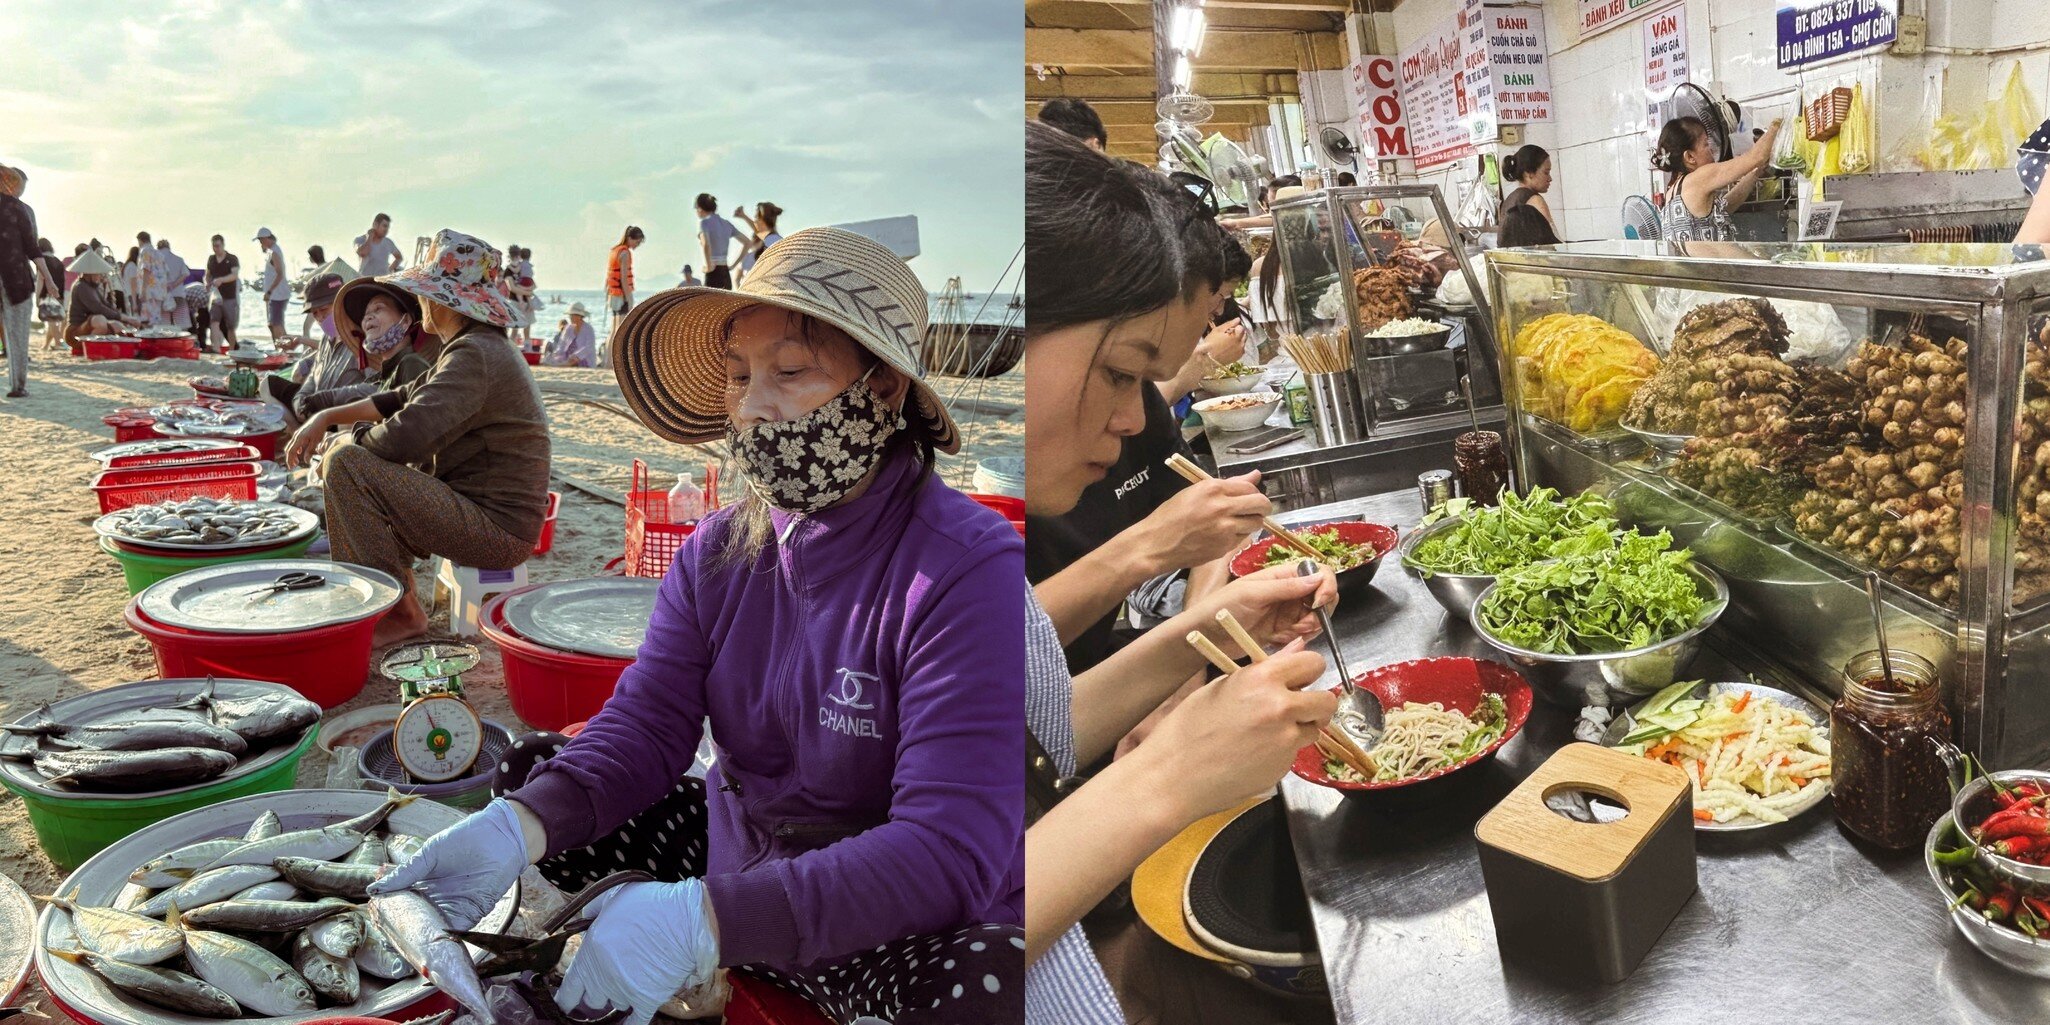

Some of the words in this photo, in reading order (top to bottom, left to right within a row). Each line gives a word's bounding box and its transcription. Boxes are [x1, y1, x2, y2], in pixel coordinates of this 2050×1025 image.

[1496, 15, 1528, 30] BÁNH
[1585, 5, 1608, 28] BÁNH
[1652, 15, 1677, 38] VÂN
[1795, 14, 1809, 35] ĐT:
[1811, 6, 1834, 30] 0824
[1836, 0, 1853, 22] 337
[1792, 42, 1803, 61] 04
[1804, 34, 1825, 58] ĐÌNH
[1827, 29, 1843, 51] 15A
[1493, 51, 1512, 65] CUỐN
[1512, 53, 1526, 64] HEO
[1527, 53, 1543, 65] QUAY
[1503, 71, 1535, 86] BÁNH
[1367, 57, 1409, 157] CƠM
[819, 707, 882, 740] CHANEL
